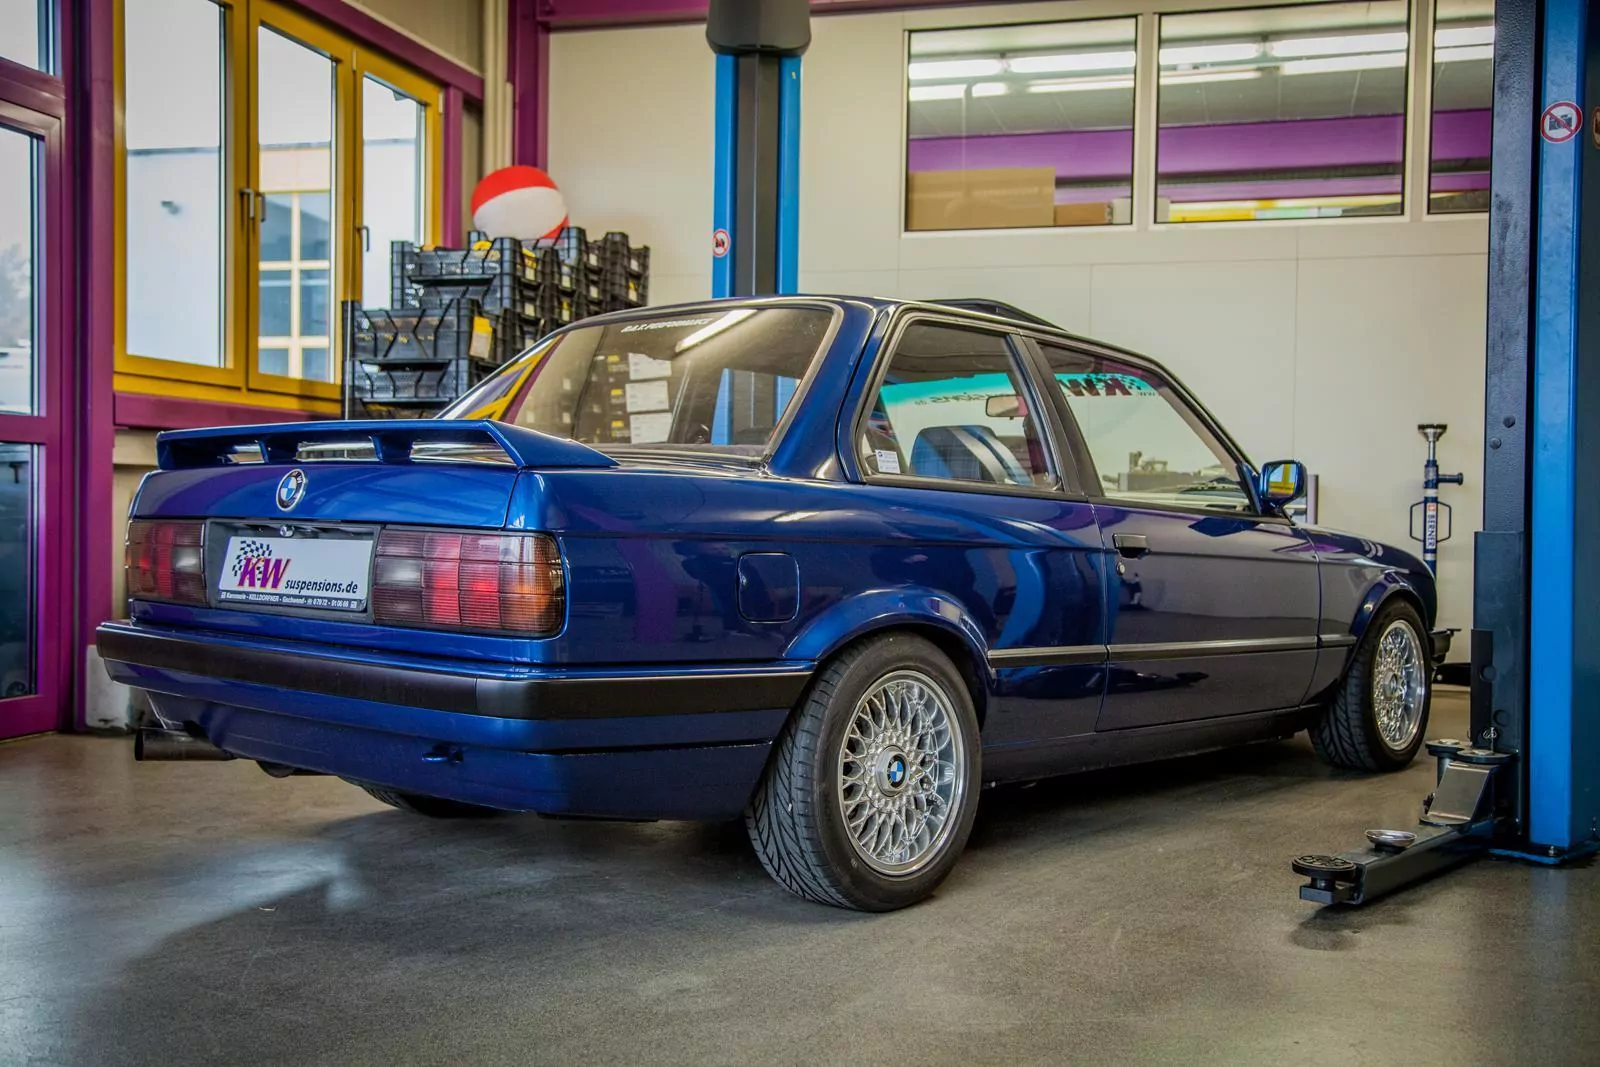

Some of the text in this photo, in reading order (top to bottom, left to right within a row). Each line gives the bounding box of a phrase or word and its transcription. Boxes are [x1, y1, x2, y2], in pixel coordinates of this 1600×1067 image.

[1427, 514, 1436, 548] BERNER
[238, 556, 358, 594] KW suspensions.de
